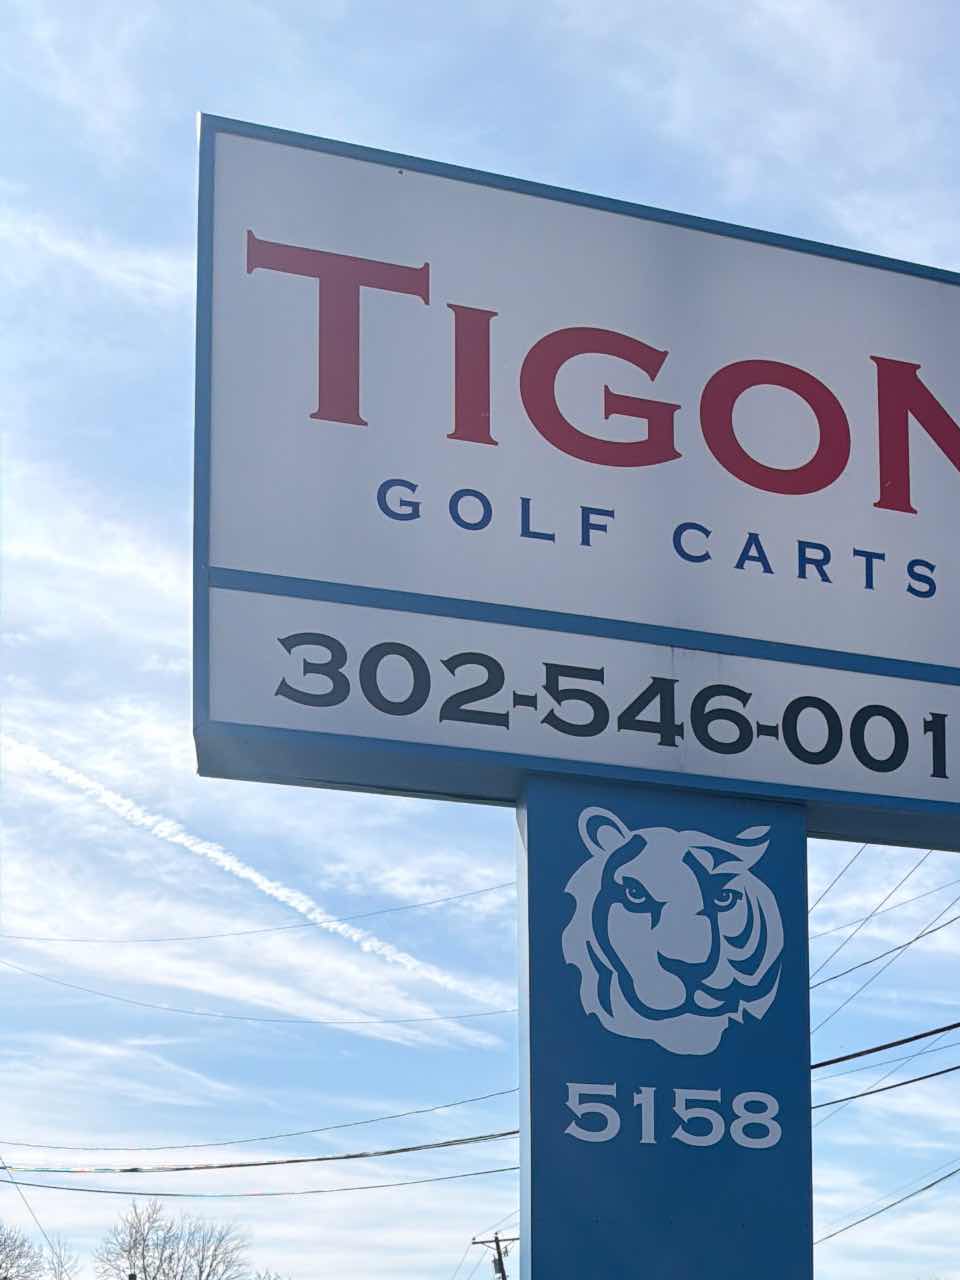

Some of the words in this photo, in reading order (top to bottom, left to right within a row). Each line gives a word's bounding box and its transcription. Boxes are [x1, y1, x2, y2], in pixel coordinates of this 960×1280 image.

[376, 478, 616, 547] GOLF
[672, 521, 938, 599] CARTS
[564, 1082, 782, 1149] 5158
